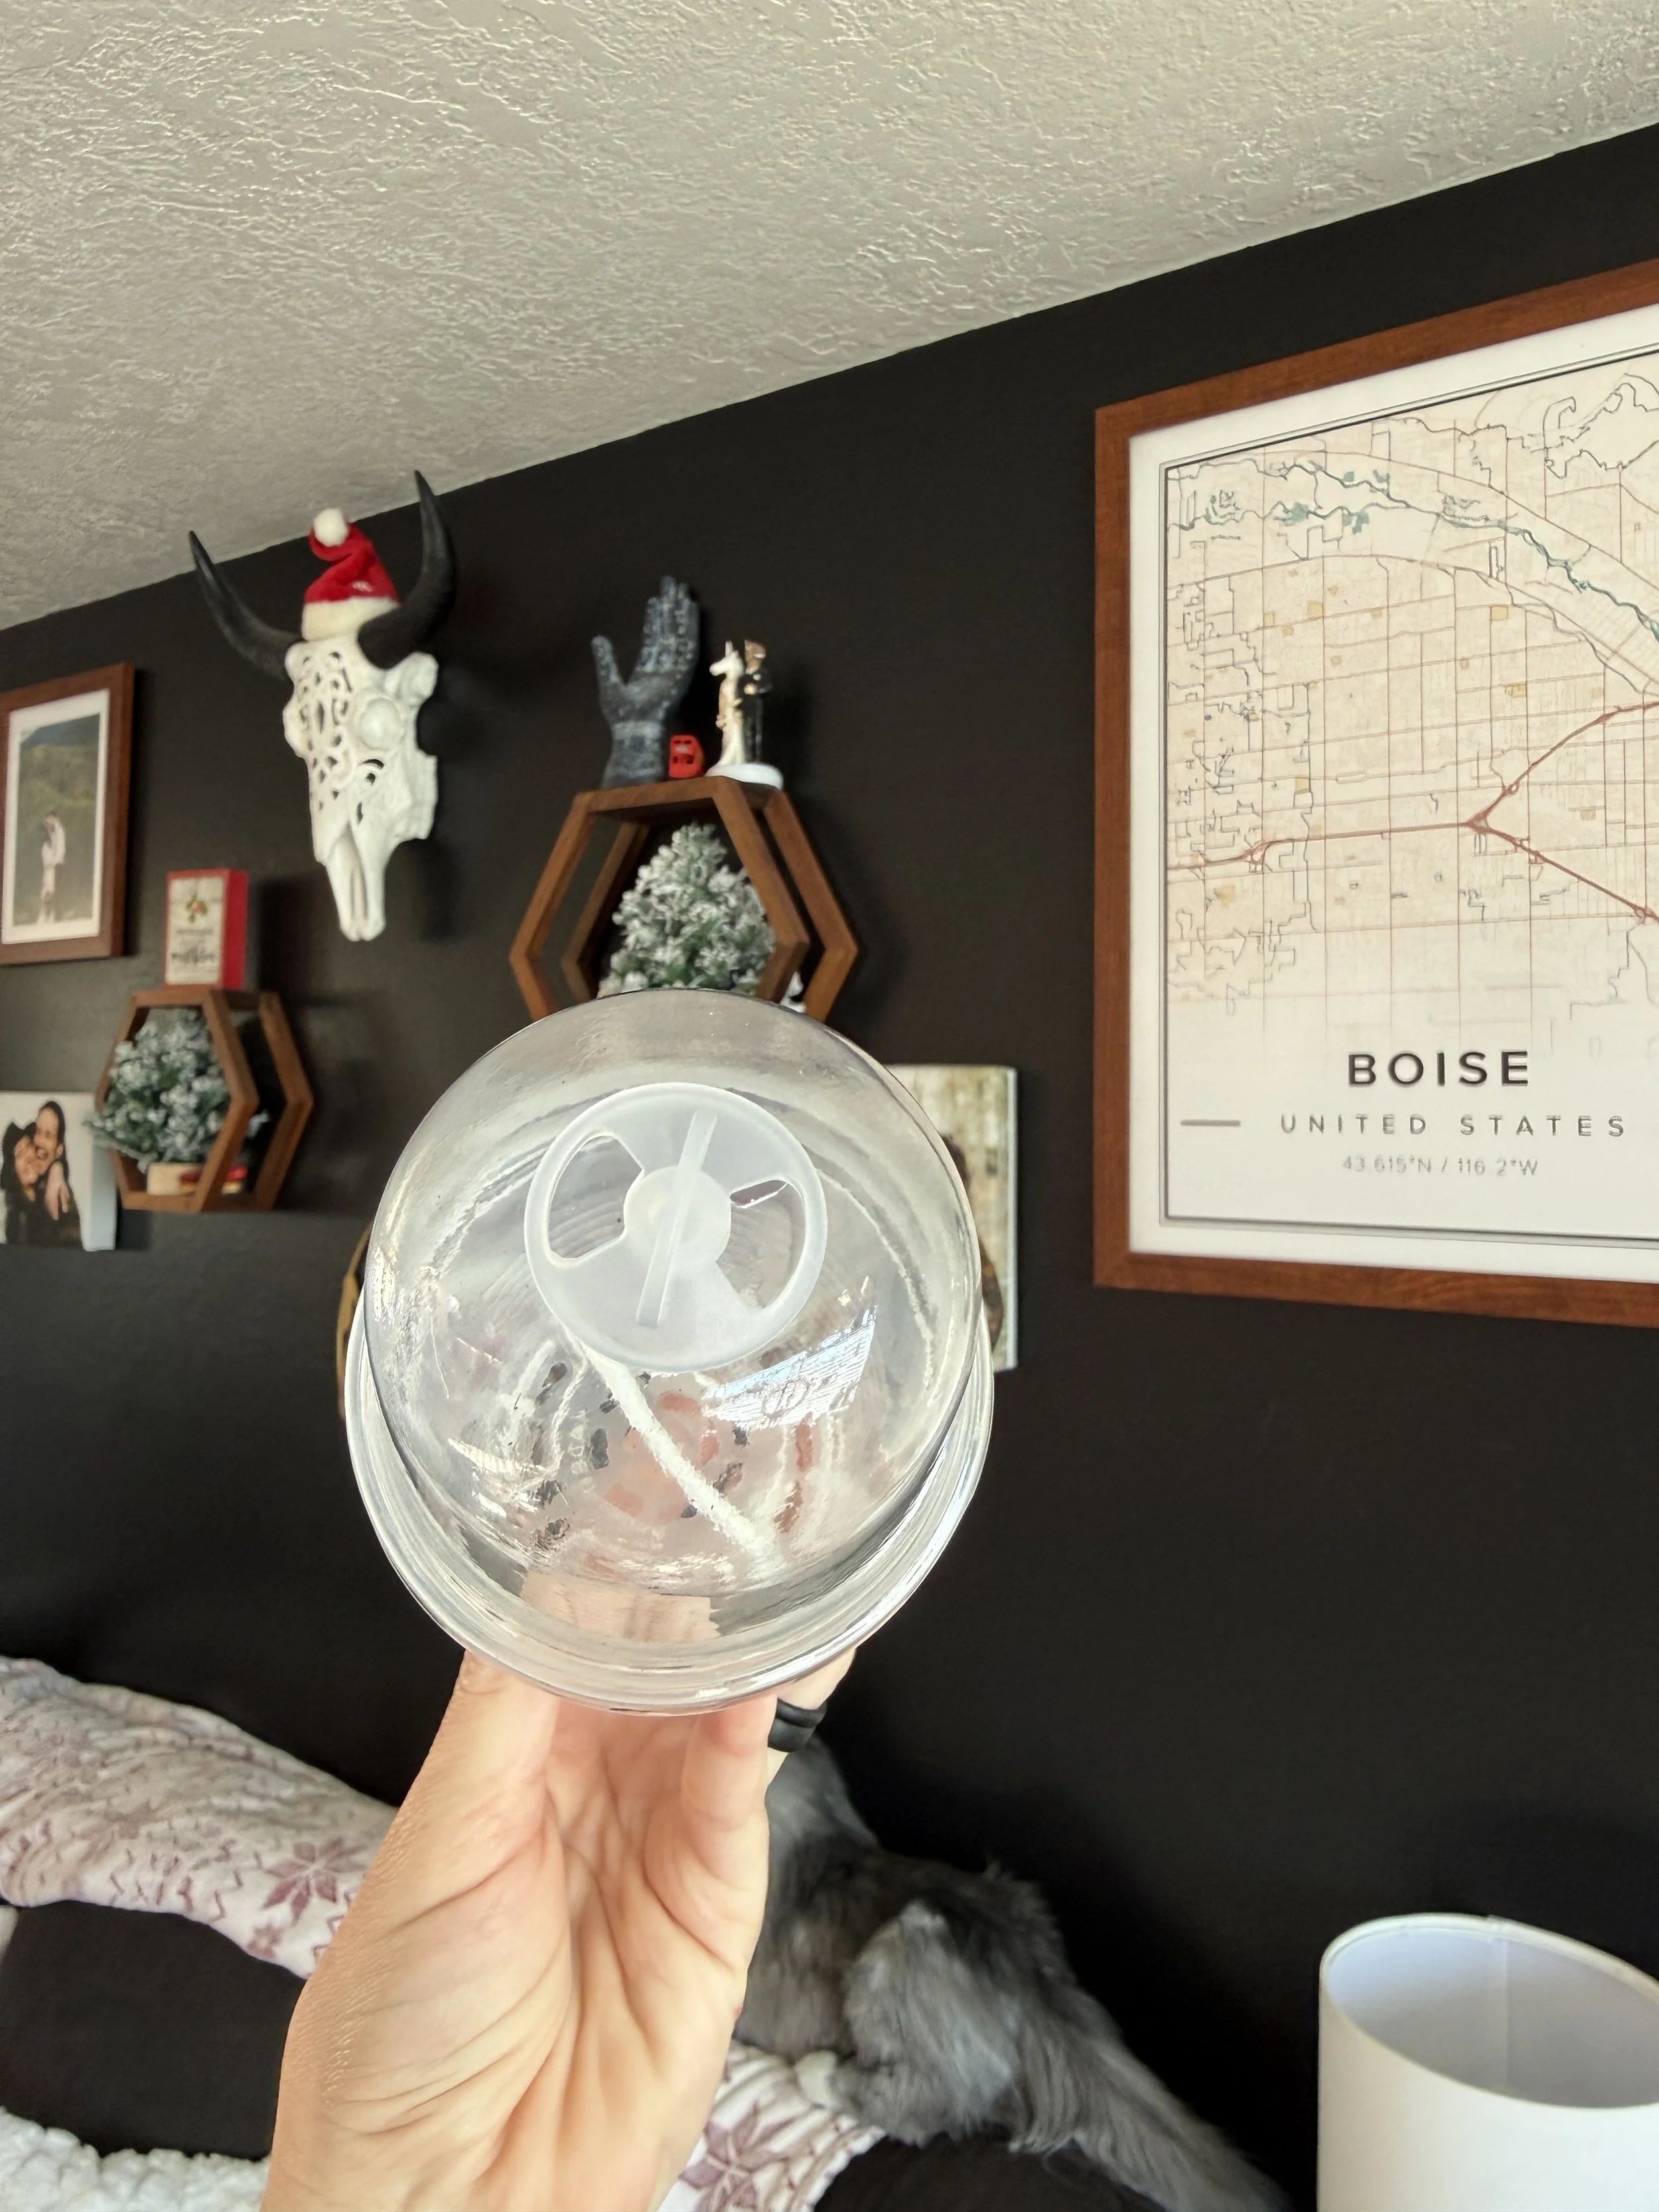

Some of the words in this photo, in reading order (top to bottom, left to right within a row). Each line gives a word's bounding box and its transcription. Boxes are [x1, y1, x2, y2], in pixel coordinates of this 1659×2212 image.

[1348, 1050, 1529, 1088] BOISE
[1281, 1114, 1426, 1135] UNITED
[1459, 1114, 1624, 1138] STATES
